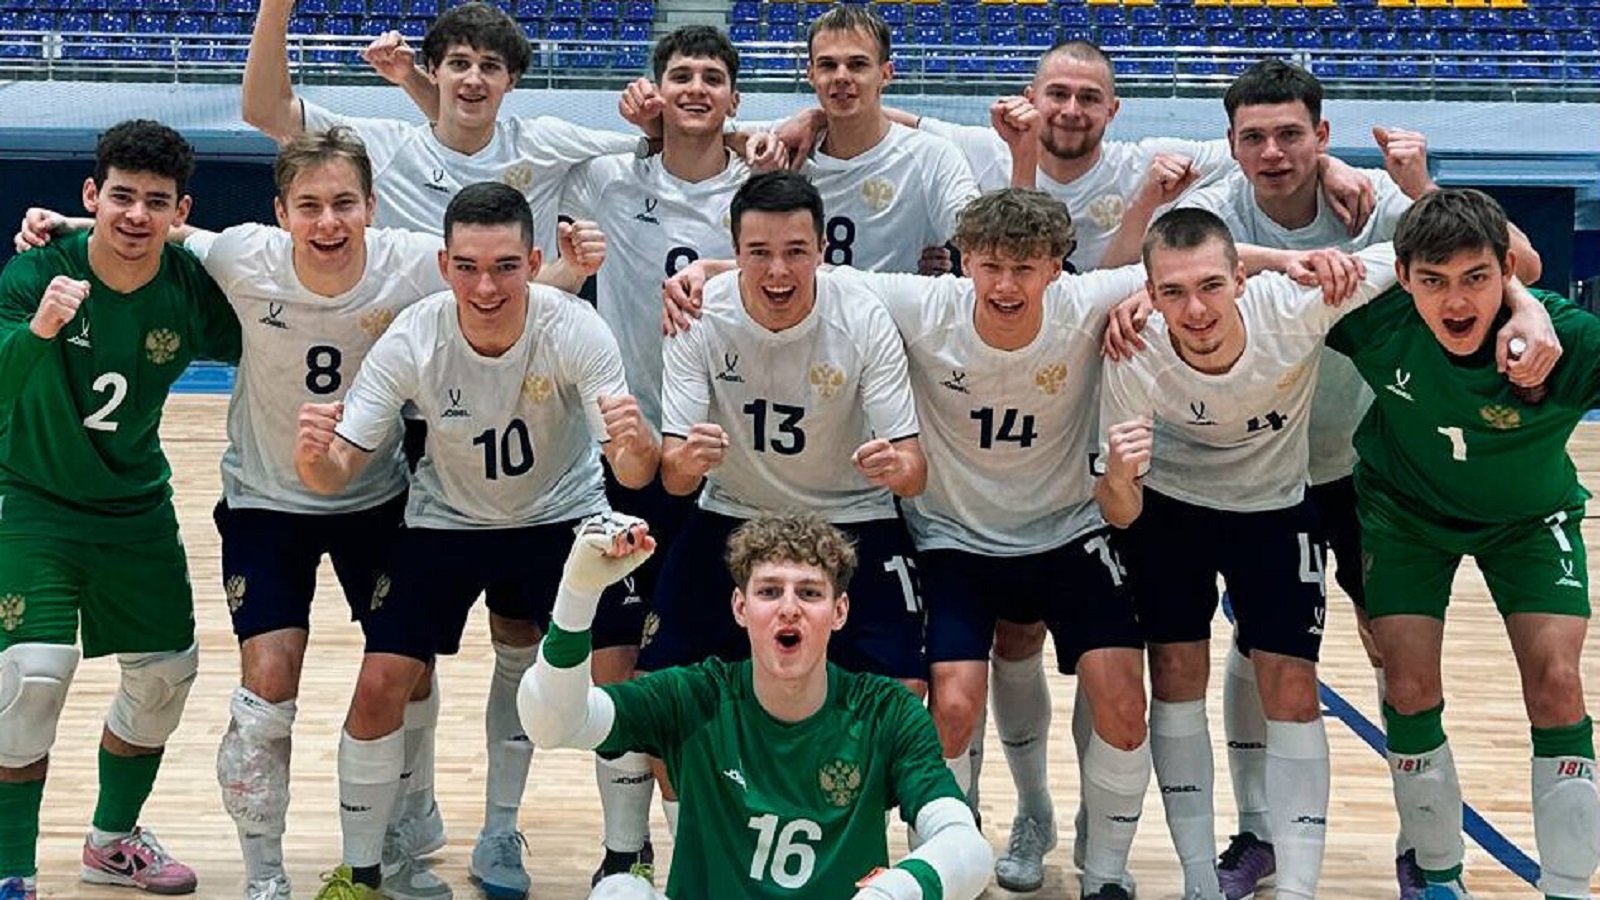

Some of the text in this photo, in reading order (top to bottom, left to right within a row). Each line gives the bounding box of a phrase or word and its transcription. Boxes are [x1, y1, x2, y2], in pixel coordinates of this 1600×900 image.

[305, 346, 342, 395] 8
[83, 371, 128, 432] 2
[743, 398, 806, 456] 13
[970, 407, 1038, 449] 14
[472, 418, 534, 480] 10
[1437, 426, 1468, 461] 1
[1543, 510, 1573, 552] 1
[883, 555, 922, 613] 1
[1083, 534, 1128, 588] 1
[1297, 532, 1326, 597] 4
[747, 812, 823, 889] 16
